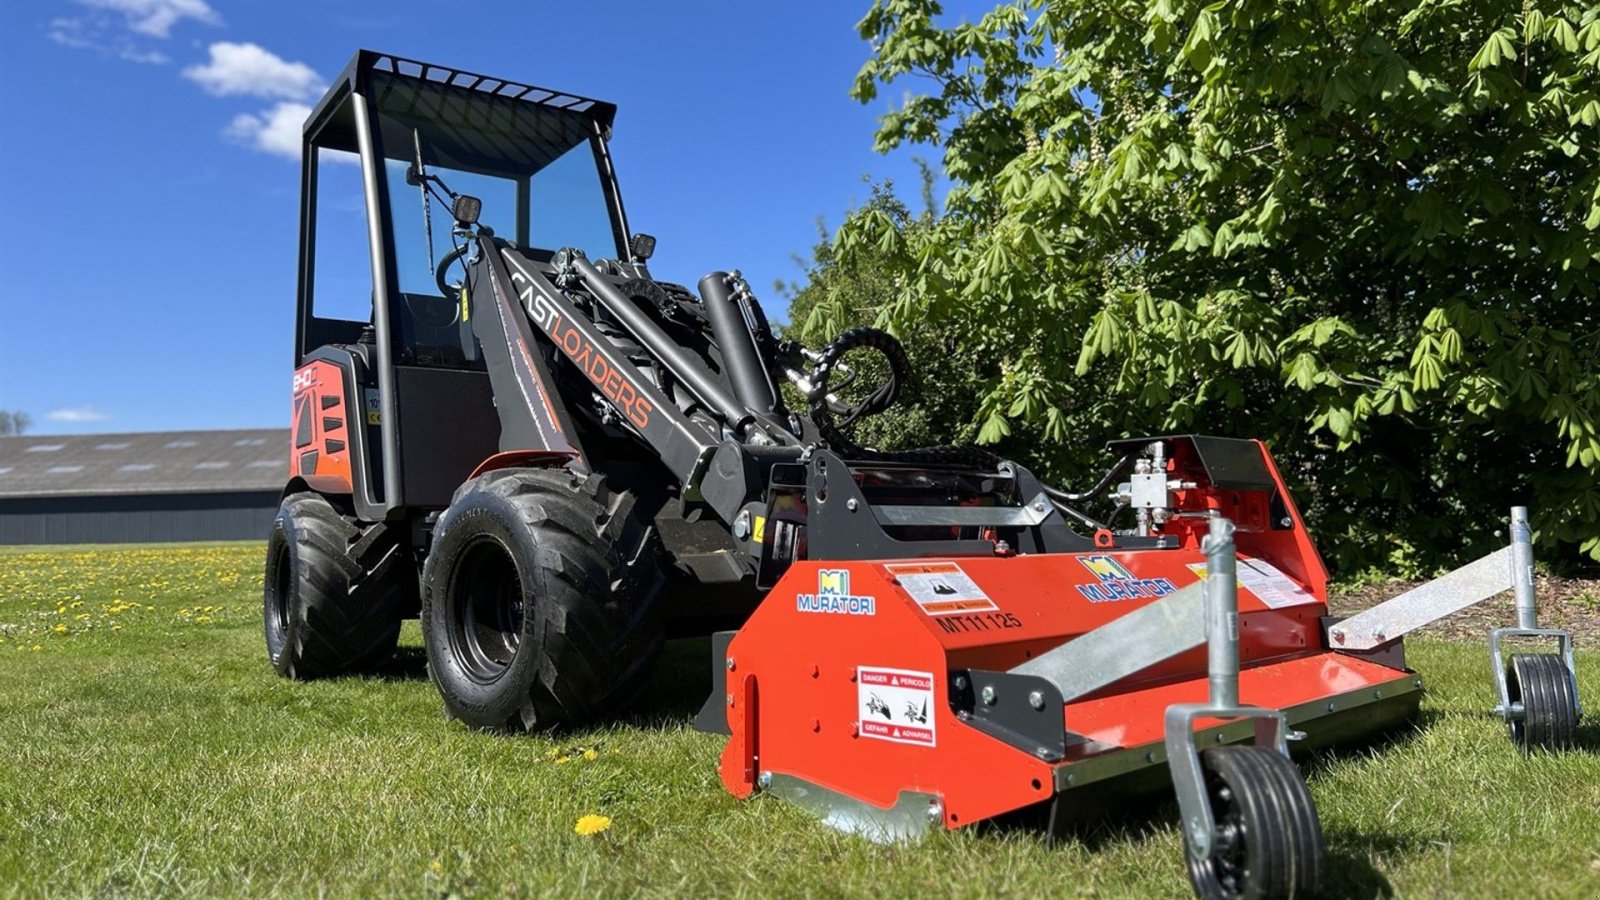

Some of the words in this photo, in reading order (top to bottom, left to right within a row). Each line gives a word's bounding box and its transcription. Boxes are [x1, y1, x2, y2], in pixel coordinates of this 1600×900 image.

[1076, 578, 1179, 602] MURATORI
[798, 595, 875, 614] MURATORI
[936, 614, 989, 633] MT11
[987, 613, 1022, 629] 125
[862, 673, 888, 682] DANGER
[900, 677, 930, 688] PERICOLO
[864, 723, 888, 734] GEFAHR
